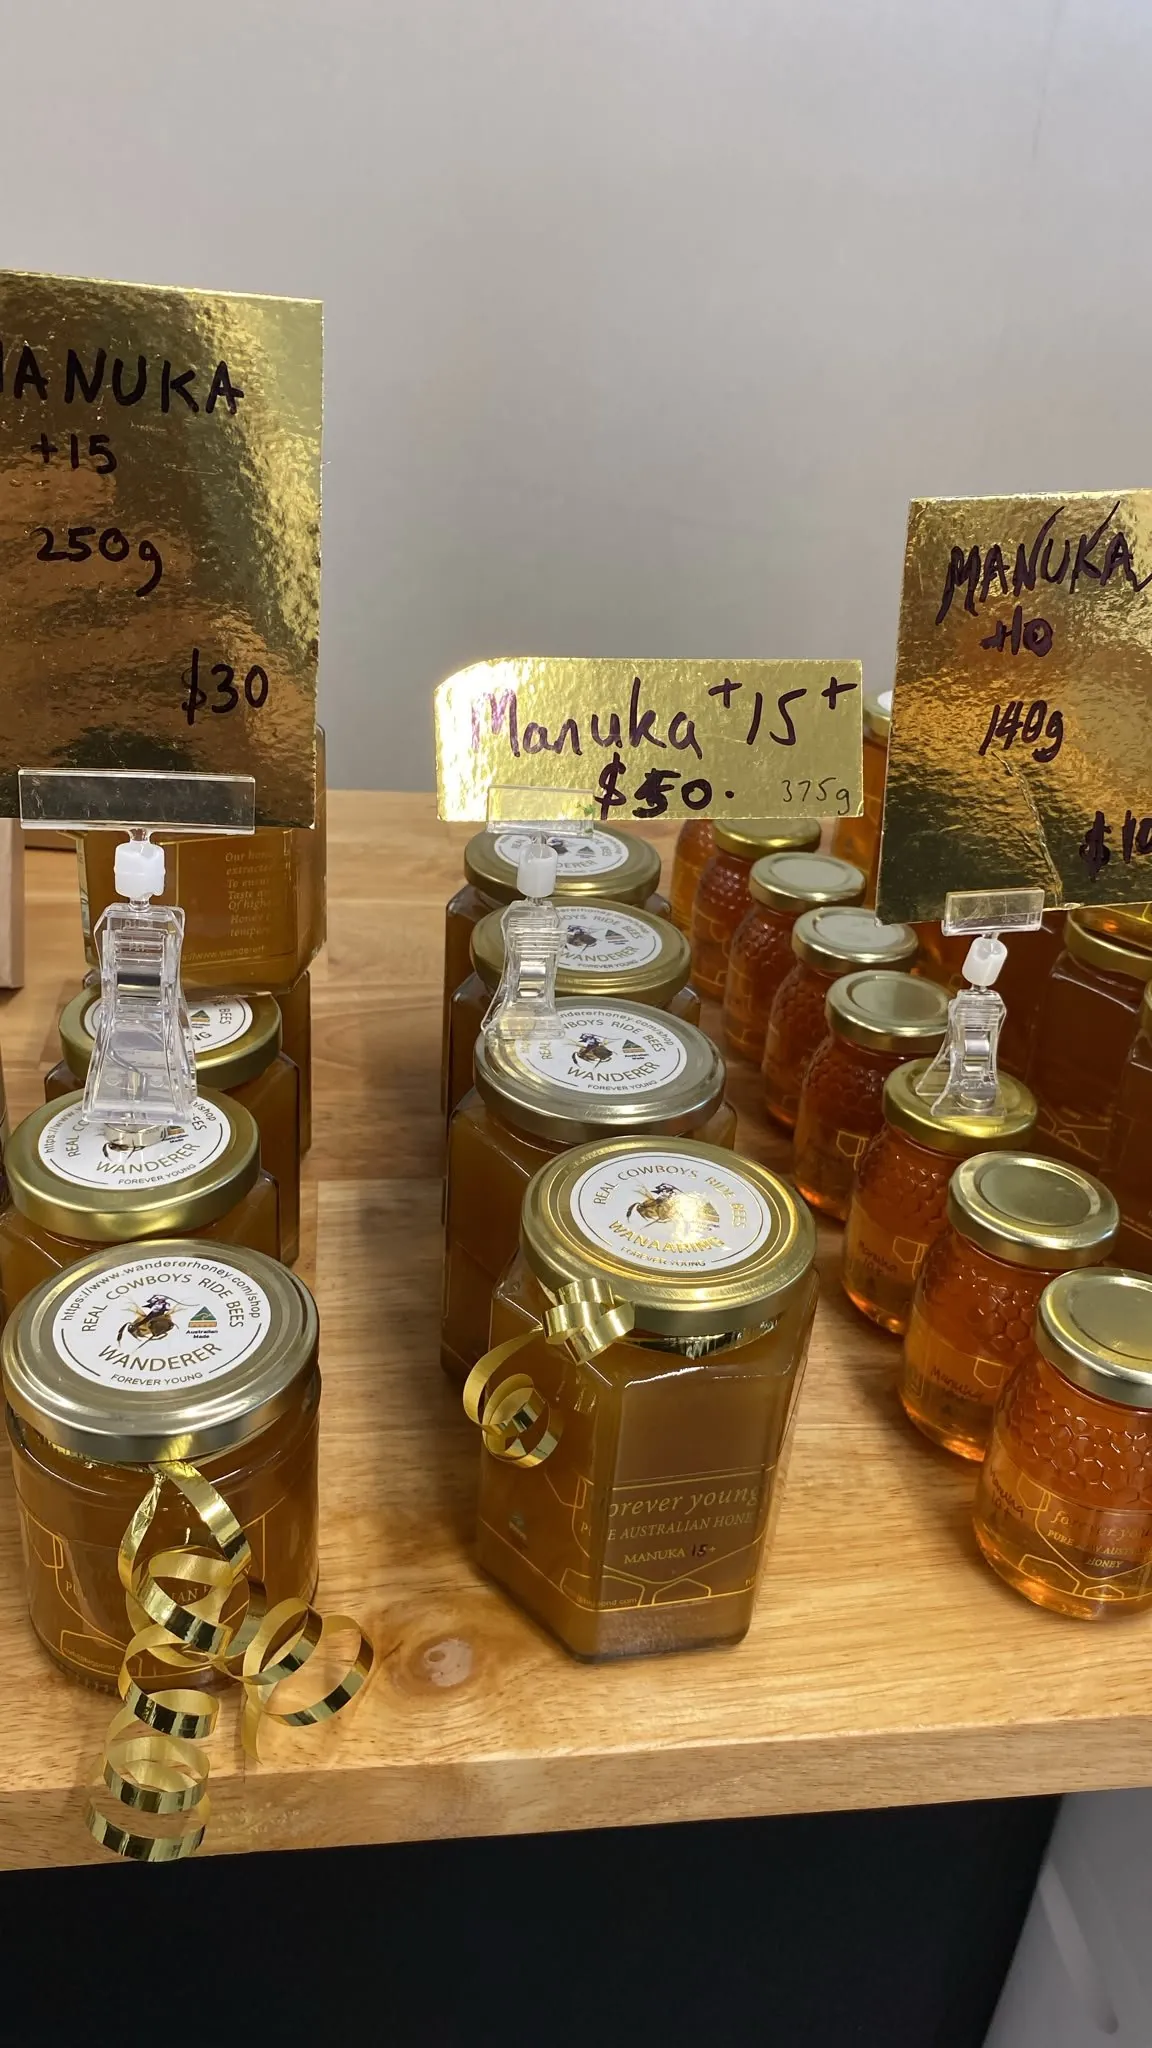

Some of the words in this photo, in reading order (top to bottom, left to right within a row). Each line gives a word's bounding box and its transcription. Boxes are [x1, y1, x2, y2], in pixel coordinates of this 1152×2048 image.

[0, 341, 245, 415] ANUKA
[30, 433, 118, 474] +15
[30, 526, 163, 598] 250g
[935, 500, 1152, 626] MANUKA
[979, 605, 1054, 658] +10
[181, 647, 269, 726] $30
[470, 677, 703, 759] Manuka
[978, 700, 1064, 763] 140g
[780, 777, 851, 816] 375g
[611, 1021, 643, 1035] RIDE
[643, 1034, 666, 1053] BEES
[567, 1062, 661, 1082] WANDERER
[587, 1083, 629, 1091] FOREVER
[631, 1079, 658, 1090] YOUNG
[65, 1135, 81, 1158] REAL
[96, 1142, 201, 1174] WANDERER
[118, 1175, 165, 1185] FOREVER
[166, 1163, 197, 1178] YOUNG
[593, 1182, 619, 1205] REAL
[617, 1165, 699, 1182] COWBOYS
[61, 1260, 261, 1321] https://www.wandererhoney.com/shop
[82, 1304, 108, 1332] REAL
[106, 1273, 194, 1301] COWBOYS
[197, 1277, 234, 1299] RIDE
[225, 1300, 245, 1328] BEES
[98, 1343, 222, 1371] WANDERER
[111, 1374, 161, 1386] FOREVER
[164, 1372, 204, 1385] YOUNG
[619, 1517, 713, 1540] AUSTRALIAN
[1047, 1529, 1075, 1546] PURE
[623, 1547, 687, 1565] MANUKA
